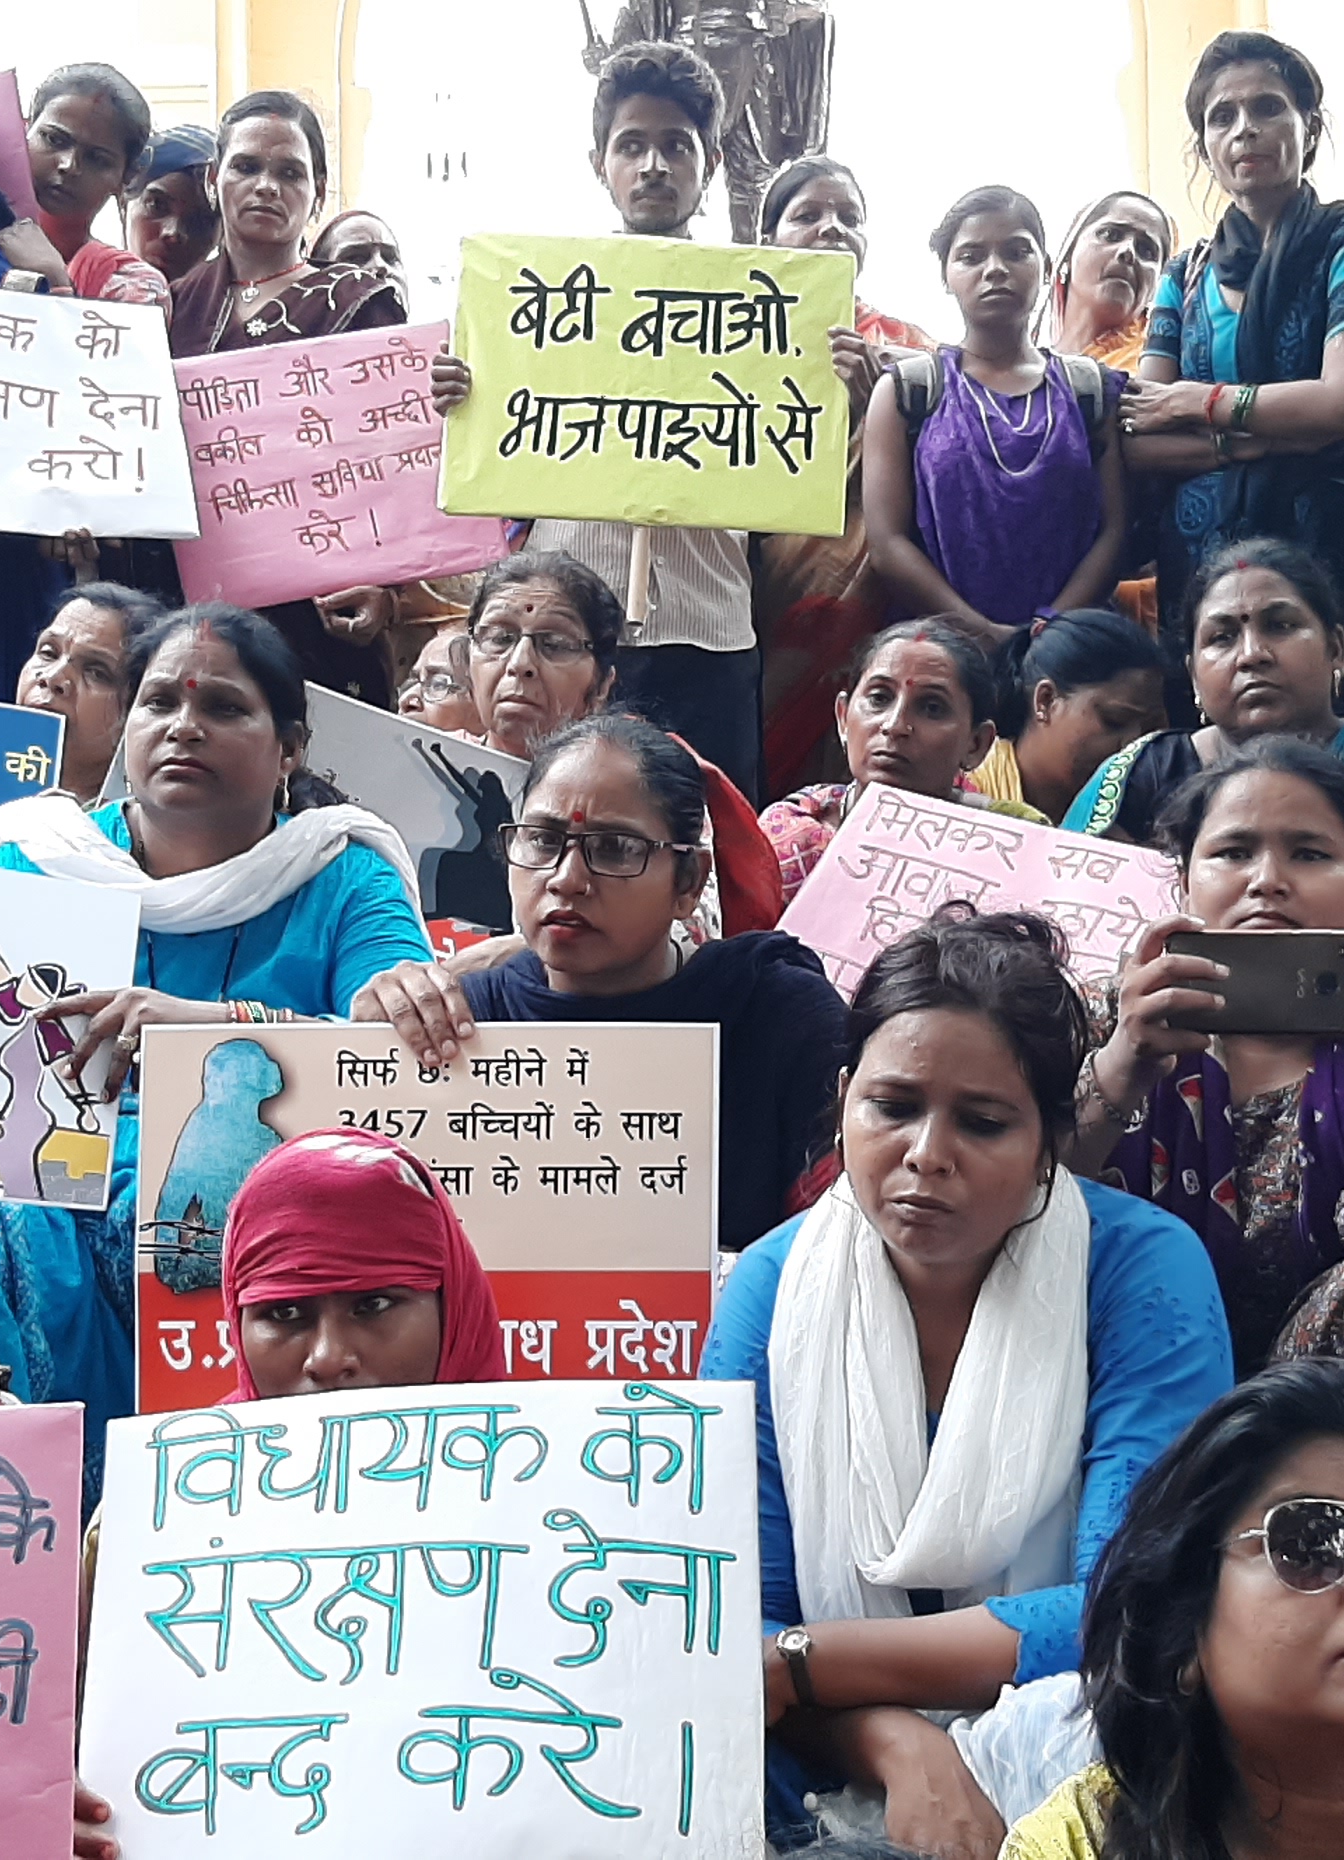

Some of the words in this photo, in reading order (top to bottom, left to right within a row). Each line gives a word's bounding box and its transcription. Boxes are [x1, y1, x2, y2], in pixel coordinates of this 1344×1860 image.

[75, 309, 131, 359] को
[509, 263, 612, 350] बेटी
[279, 354, 335, 399] और
[343, 337, 428, 387] उसके
[79, 376, 162, 430] देना
[296, 406, 334, 448] को
[498, 371, 762, 470] भाजपाइयों
[764, 376, 824, 474] से
[4, 745, 53, 786] की
[864, 789, 1025, 872] मिलकर
[1046, 843, 1130, 884] सब
[336, 1047, 400, 1088] सिर्फ
[470, 1047, 548, 1088] महीने
[566, 1047, 590, 1087] में
[446, 1101, 556, 1141] बच्चियों
[572, 1101, 603, 1141] के
[621, 1108, 683, 1142] साथ
[491, 1155, 520, 1196] के
[538, 1155, 622, 1197] मामले
[639, 1155, 688, 1198] दर्ज
[585, 1299, 699, 1377] प्रदेश
[145, 1405, 548, 1531] विधायक
[581, 1382, 722, 1514] को
[142, 1535, 530, 1685] संरक्षण
[543, 1508, 737, 1668] देना
[134, 1712, 349, 1836] बन्द
[397, 1668, 642, 1818] करे
